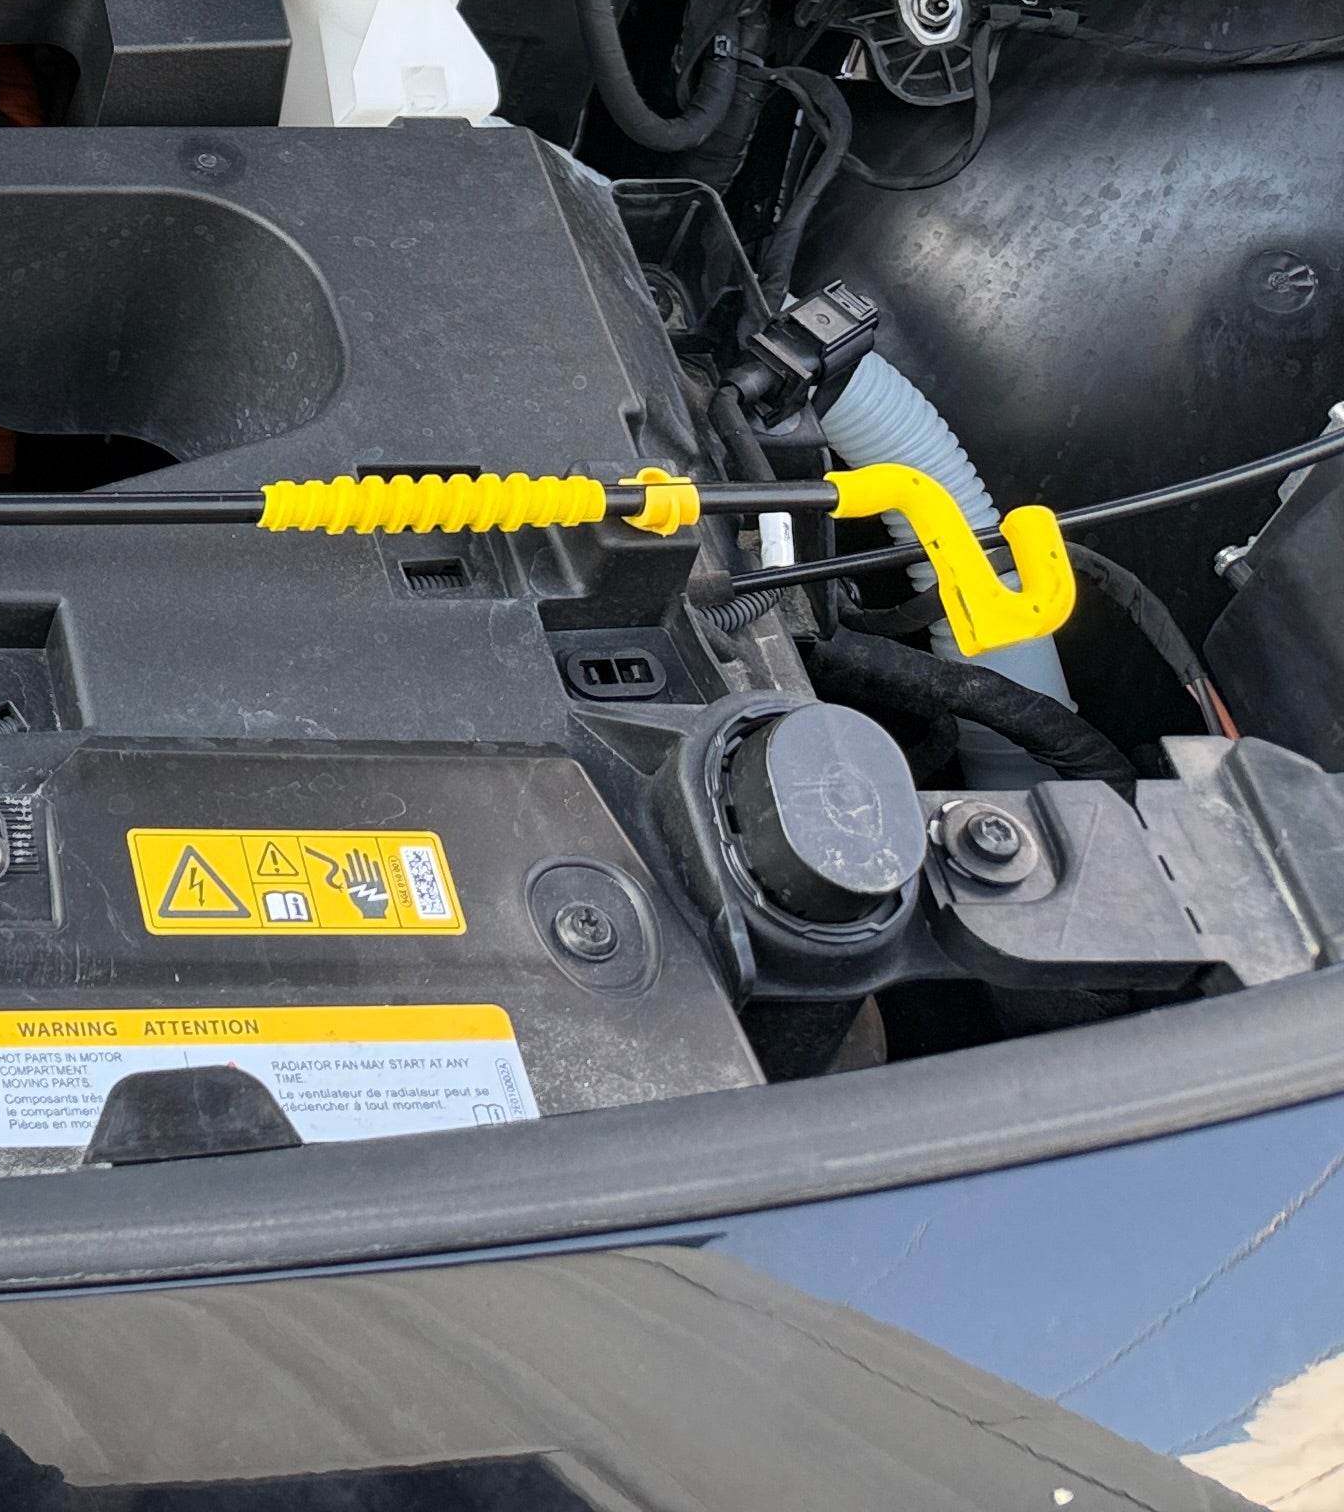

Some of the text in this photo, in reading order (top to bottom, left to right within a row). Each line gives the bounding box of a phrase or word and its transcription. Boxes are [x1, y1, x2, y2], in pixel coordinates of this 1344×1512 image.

[17, 1019, 259, 1037] WARNING ATTENTION
[24, 1052, 63, 1063] PARTS
[65, 1052, 77, 1063] IN
[79, 1051, 122, 1063] MOTOR
[271, 1057, 469, 1071] RADIATOR FAN MAY START AT ANY
[0, 1065, 88, 1076] COMPARTMENT
[2, 1078, 49, 1088] MOVING
[279, 1087, 490, 1099] Le ventilateur de radiateur peut se
[4, 1093, 79, 1106] Composants
[7, 1107, 15, 1116] le
[282, 1101, 350, 1112] déclencher
[354, 1100, 362, 1111] à
[365, 1100, 389, 1111] tout
[9, 1119, 49, 1129] Pièces
[52, 1121, 68, 1129] en
